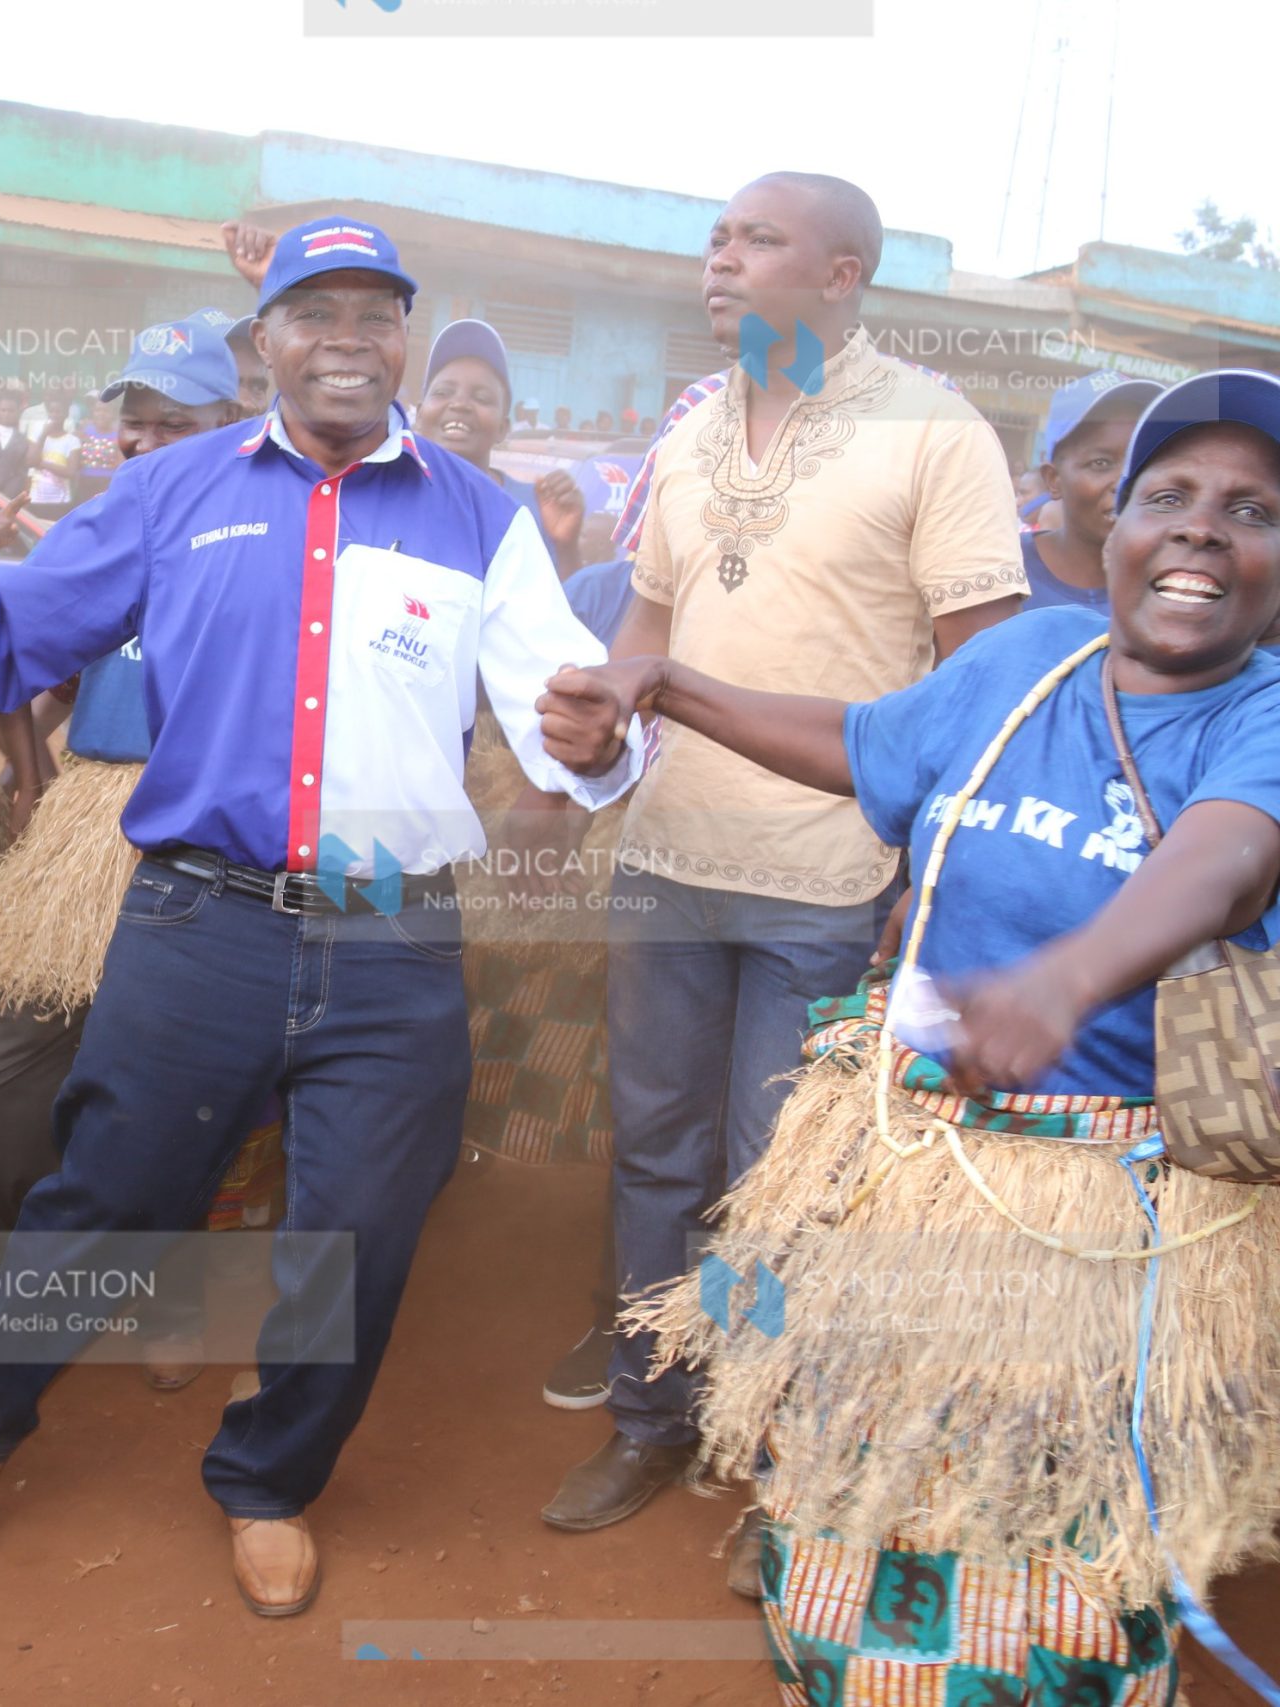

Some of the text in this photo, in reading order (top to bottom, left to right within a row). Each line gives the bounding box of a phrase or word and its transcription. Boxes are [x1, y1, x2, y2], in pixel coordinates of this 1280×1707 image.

[229, 522, 268, 538] KIRAGU
[381, 628, 428, 657] PNU
[1008, 796, 1079, 849] KK
